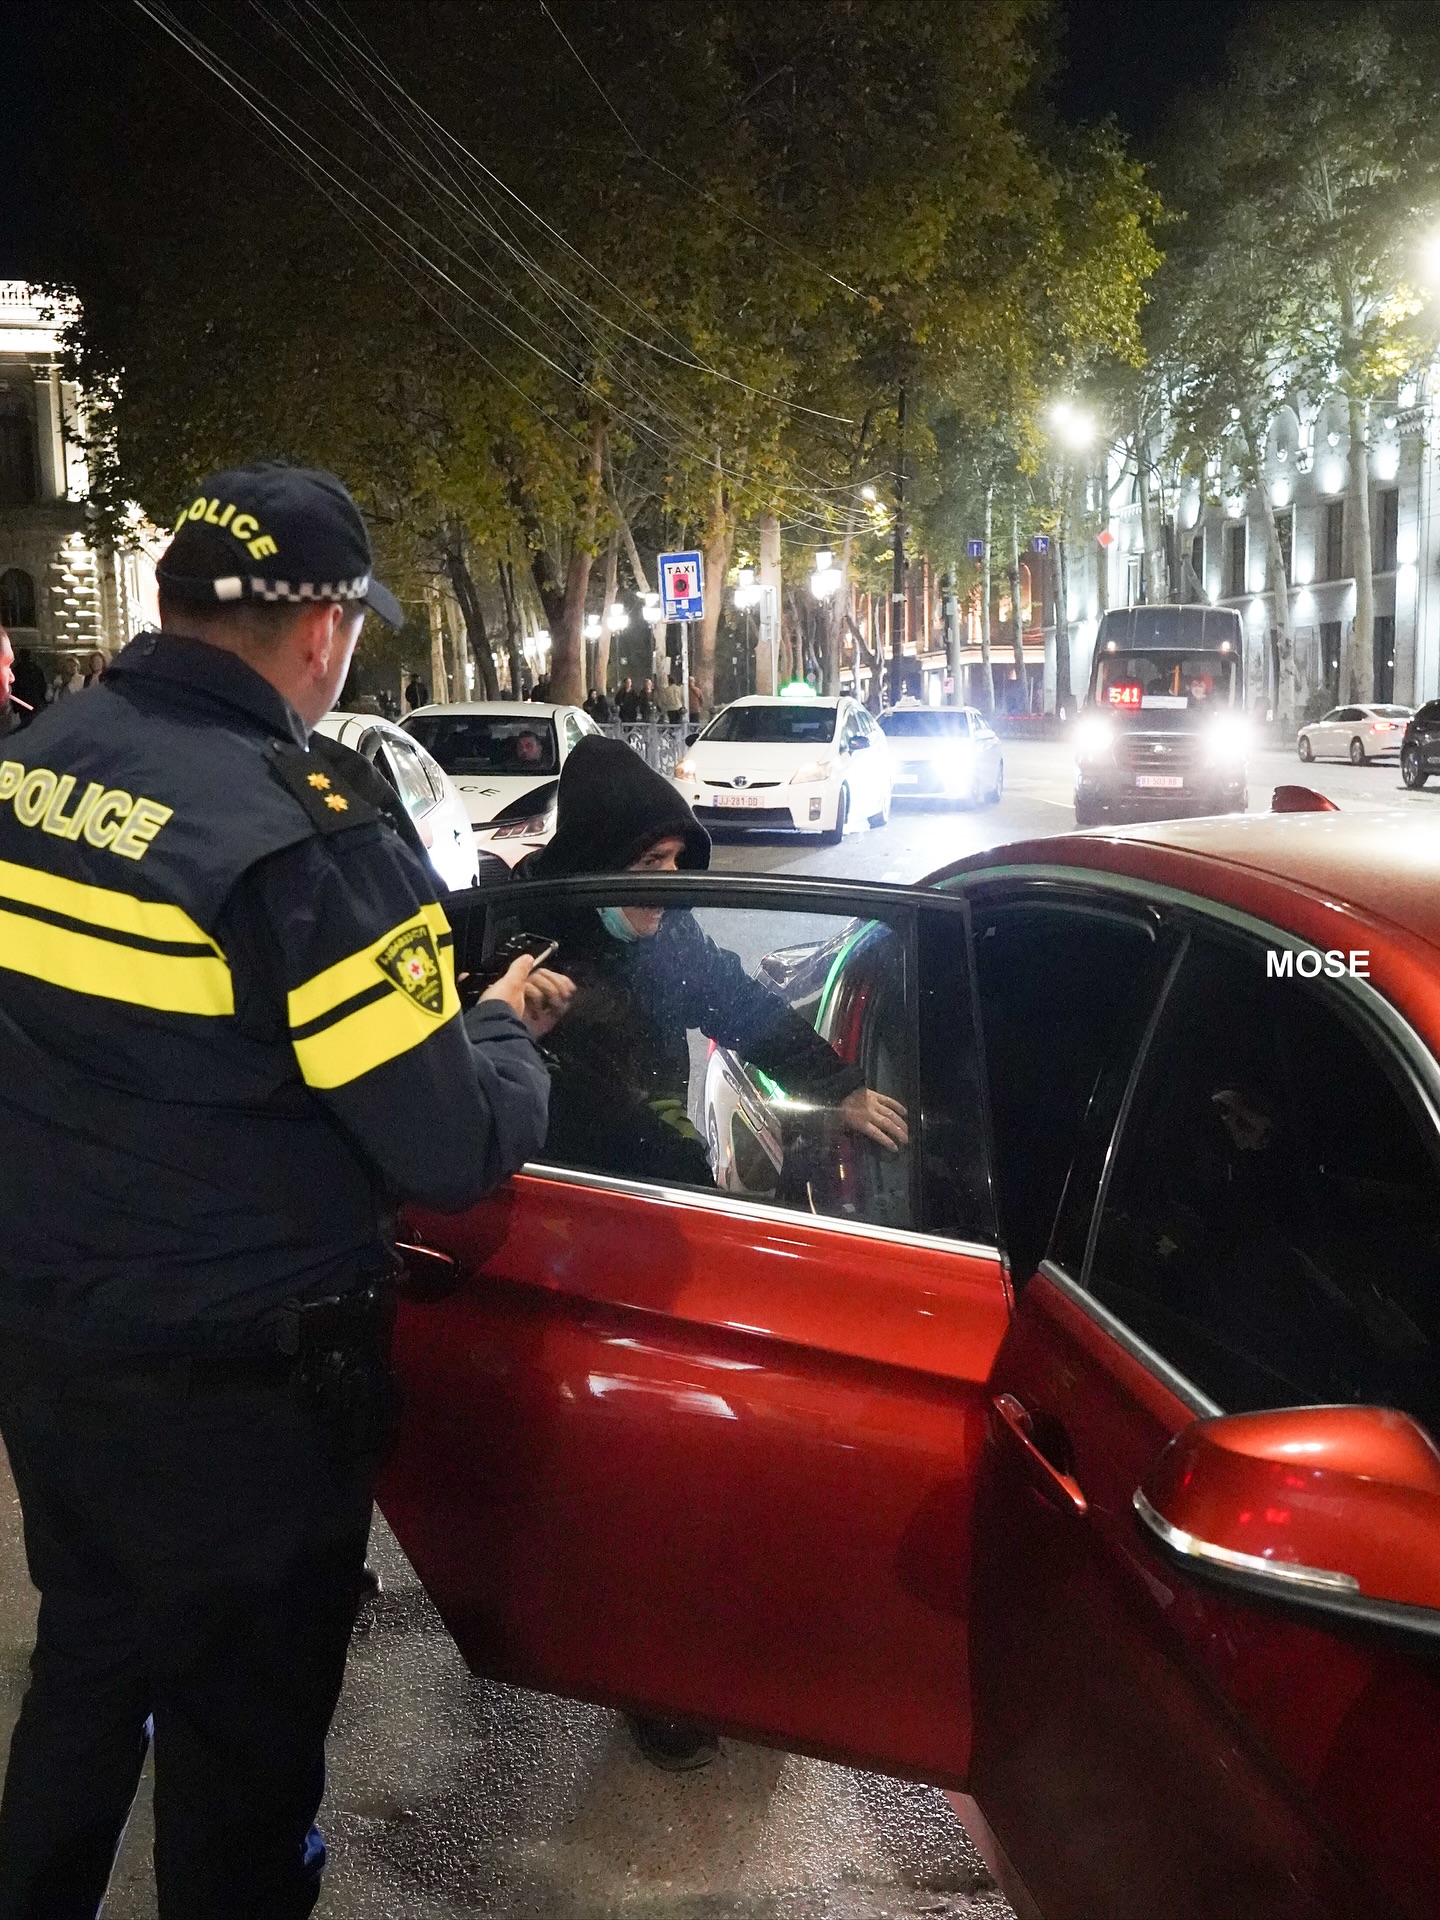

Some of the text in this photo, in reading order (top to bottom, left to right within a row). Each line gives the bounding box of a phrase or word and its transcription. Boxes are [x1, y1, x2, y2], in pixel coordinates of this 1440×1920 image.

[174, 497, 279, 560] OLICE
[667, 565, 695, 575] TAXI
[1109, 687, 1139, 702] 541
[0, 760, 174, 861] POLICE
